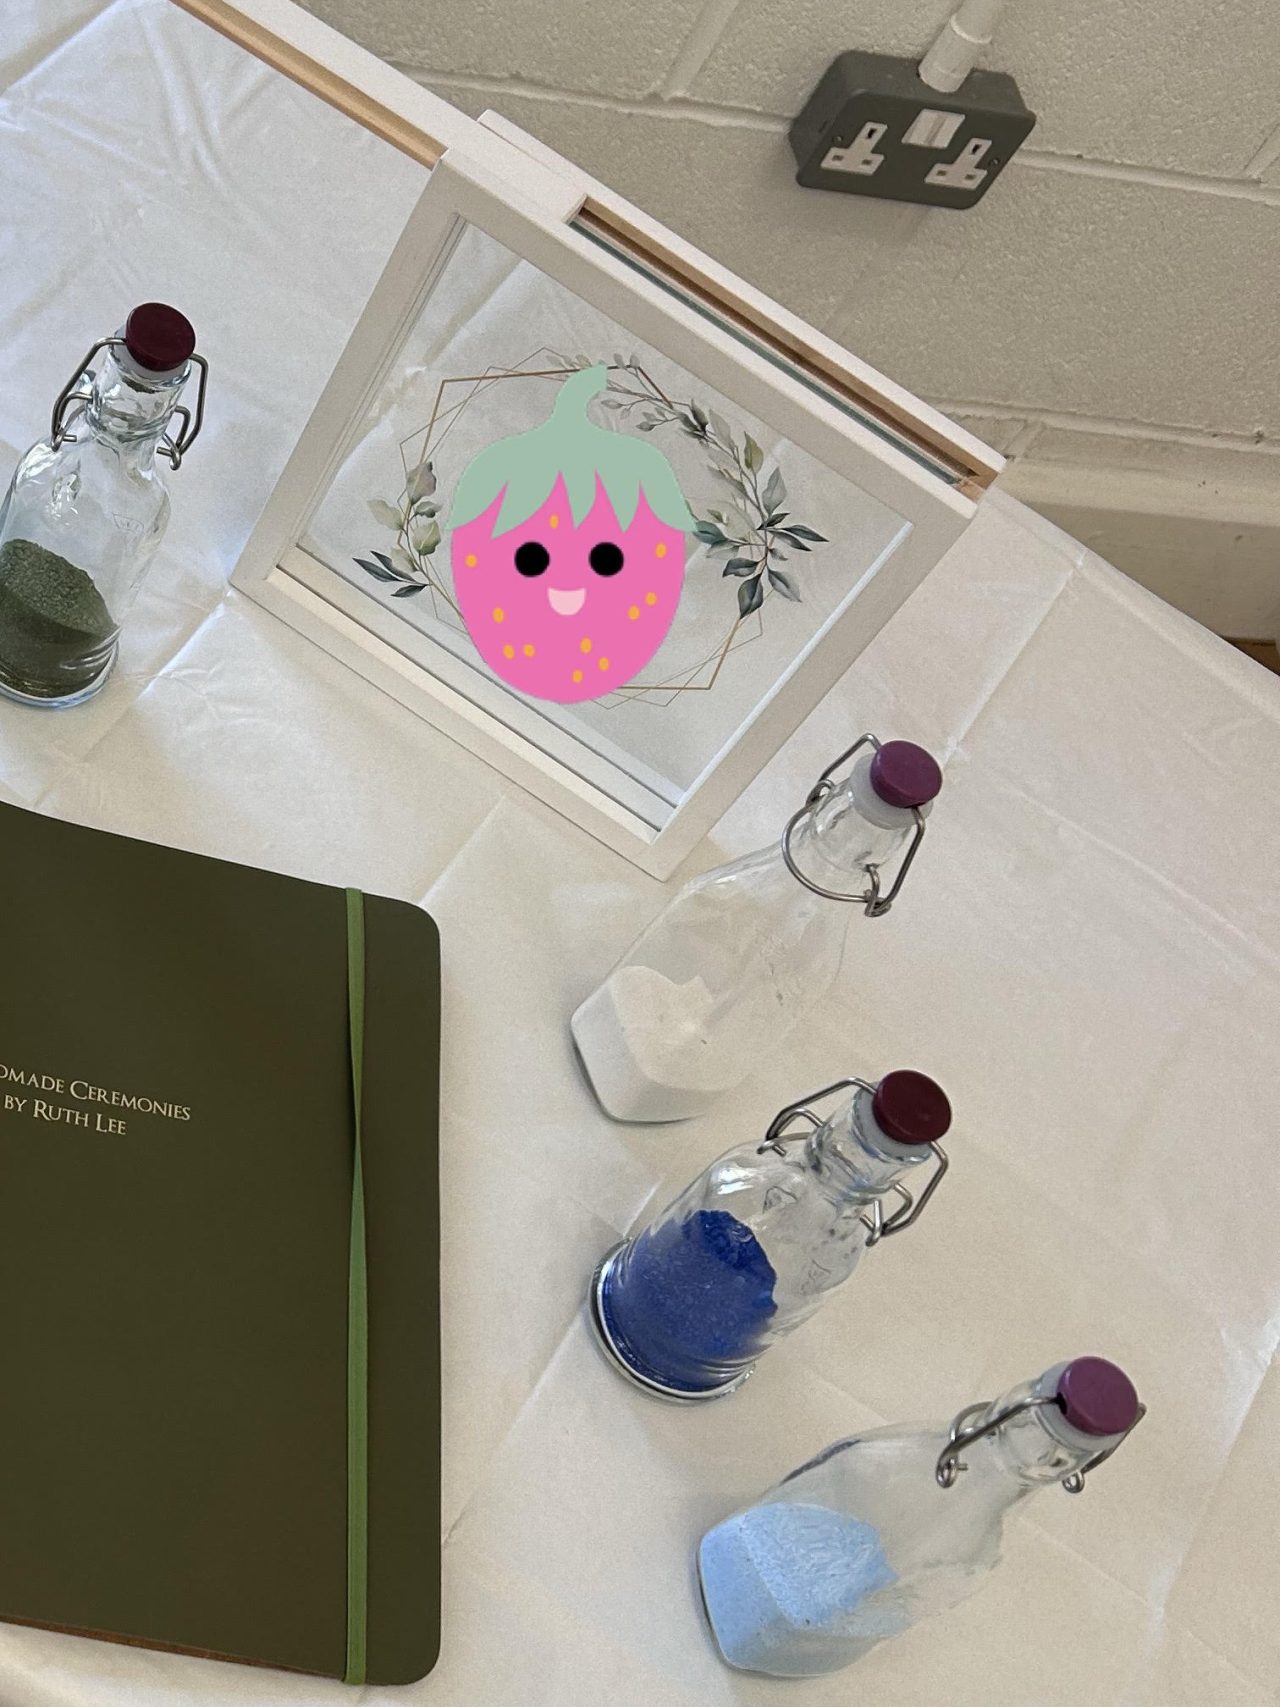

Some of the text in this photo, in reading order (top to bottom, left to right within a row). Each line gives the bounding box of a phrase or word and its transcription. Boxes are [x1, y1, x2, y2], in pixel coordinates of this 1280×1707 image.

[4, 1094, 127, 1135] BY RUTH LEE
[70, 1080, 191, 1121] CEREMONIES
